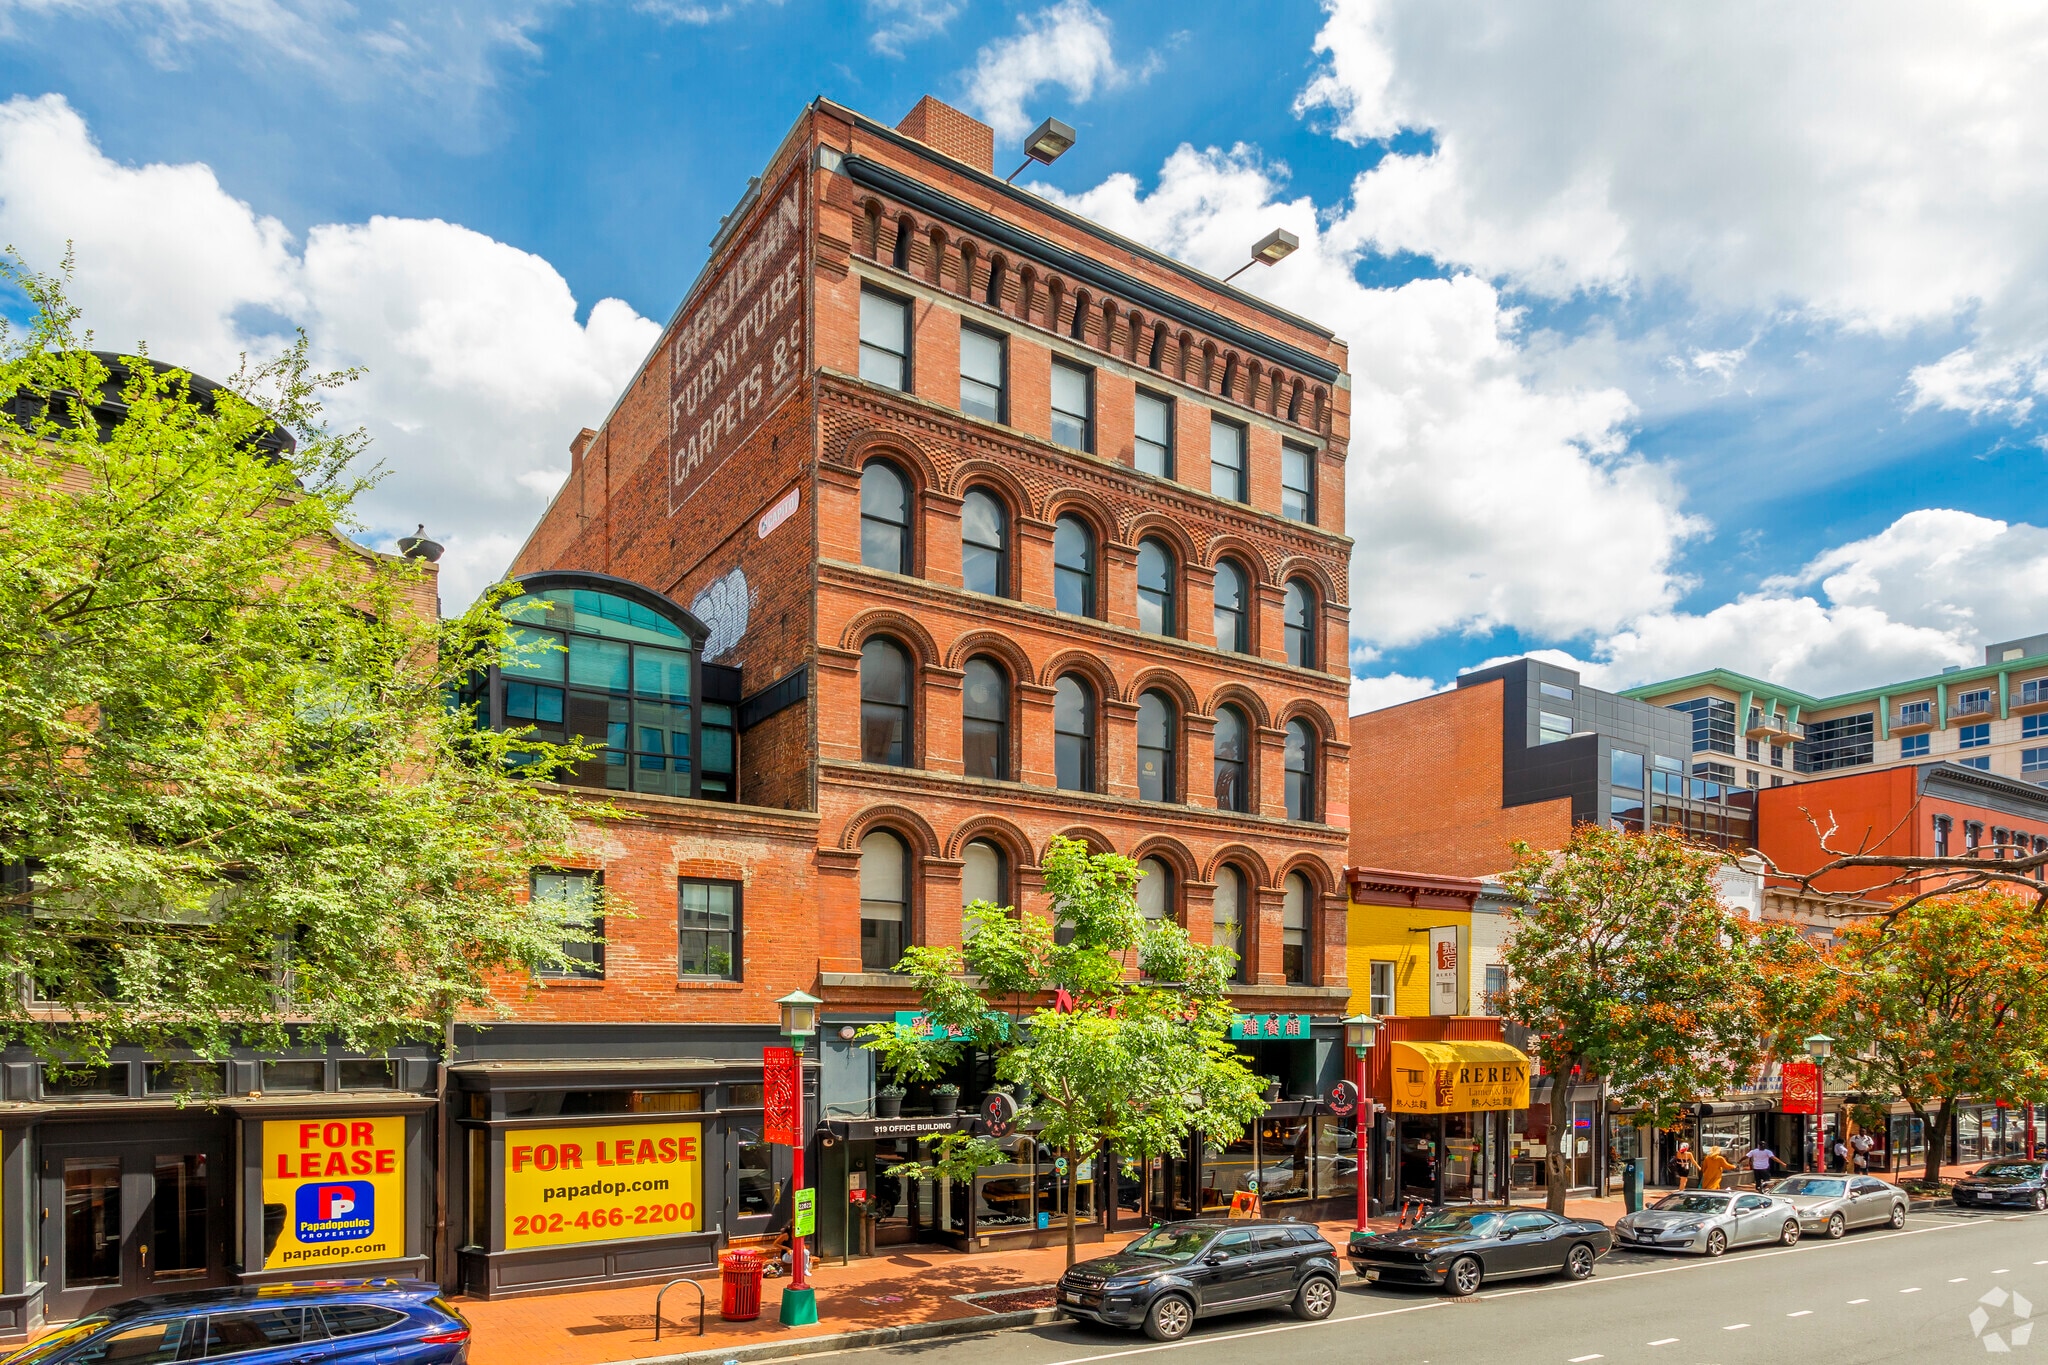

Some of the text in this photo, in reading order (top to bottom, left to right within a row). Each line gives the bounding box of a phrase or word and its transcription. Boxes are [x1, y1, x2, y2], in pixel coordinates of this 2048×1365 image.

[672, 254, 800, 435] FURNITURE
[674, 364, 762, 485] CARPETS
[71, 1074, 97, 1087] 827
[1460, 1066, 1526, 1084] REREN
[299, 1122, 375, 1149] FOR
[888, 1124, 916, 1132] OFFICE
[917, 1122, 952, 1131] BUILDING
[277, 1149, 396, 1179] LEASE
[511, 1136, 697, 1173] FOR LEASE
[543, 1178, 669, 1203] papadop.com
[300, 1218, 370, 1232] Papadopoulos
[512, 1202, 696, 1236] 202-466-2200
[301, 1229, 370, 1239] PROPERTIES
[283, 1241, 386, 1262] papadop.com
